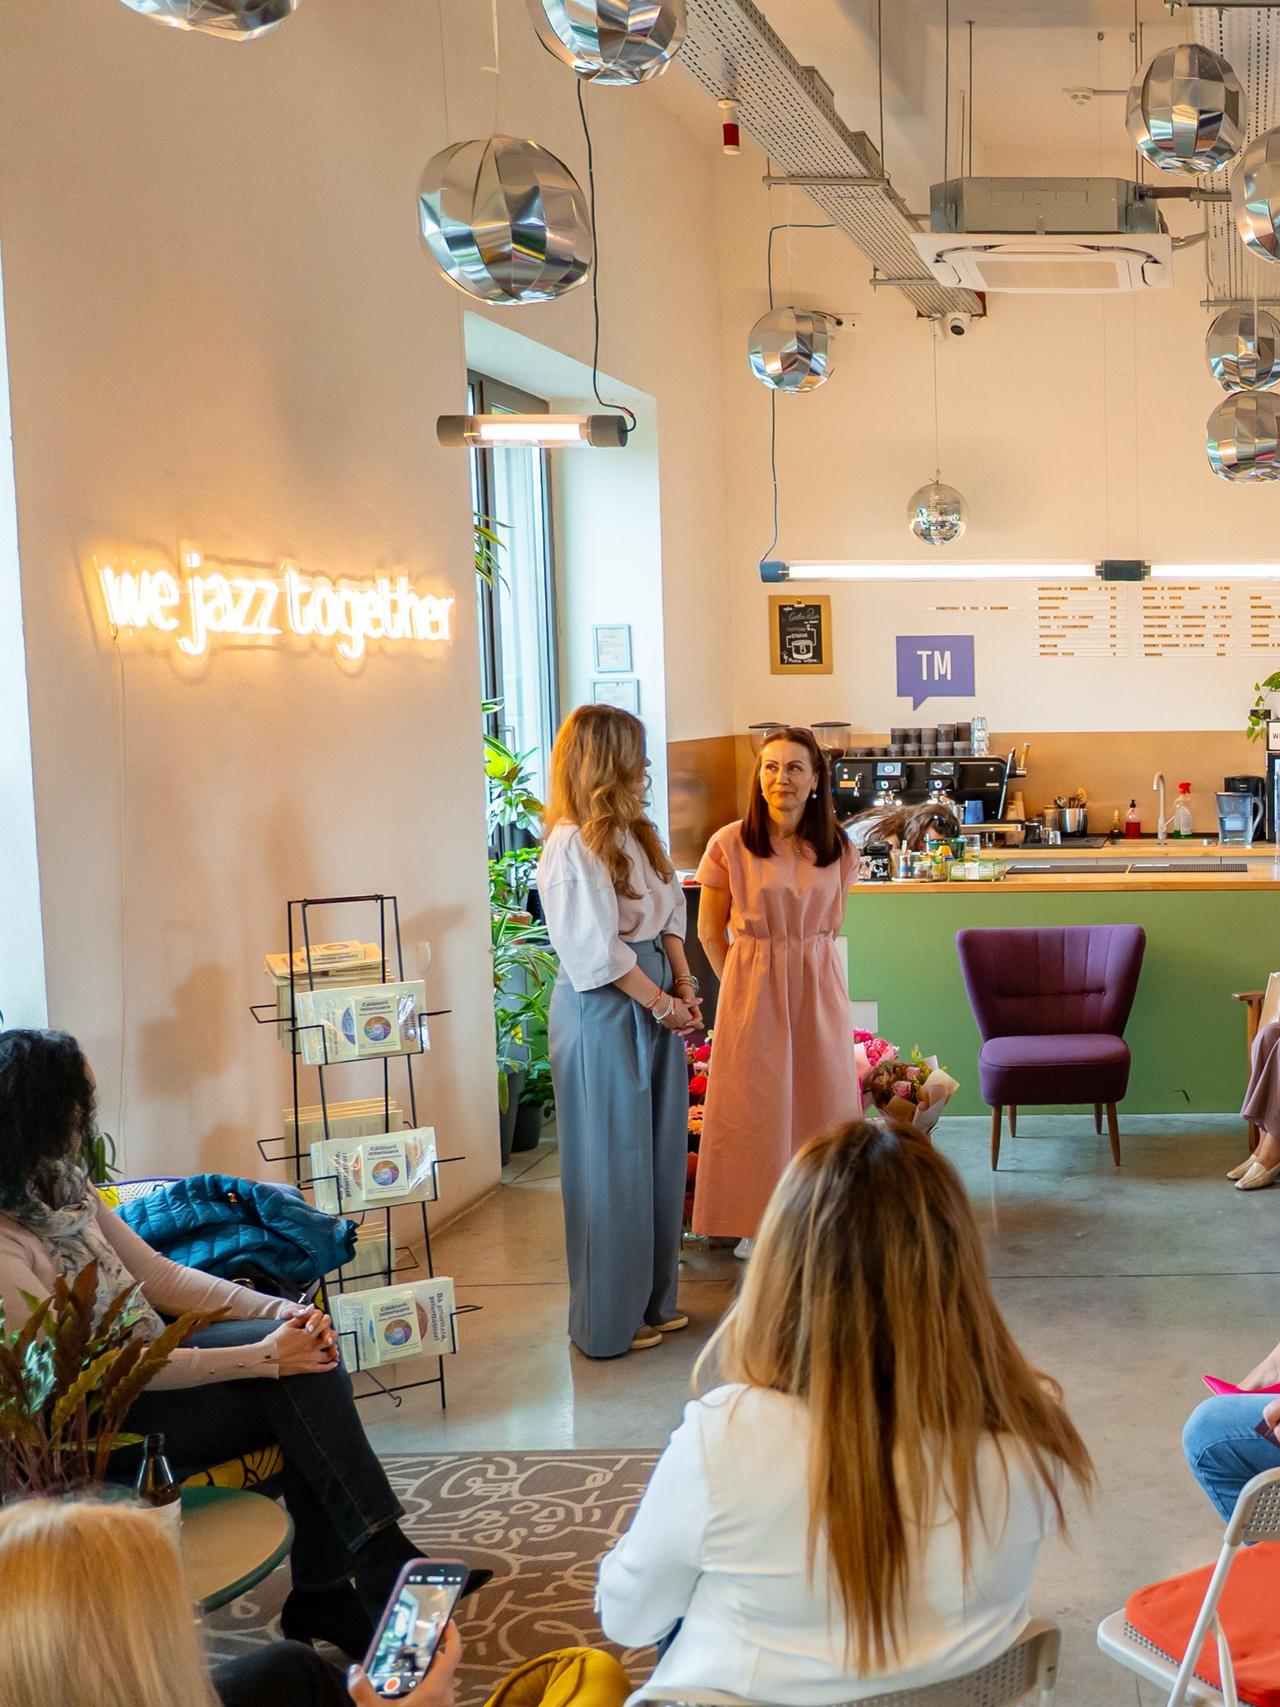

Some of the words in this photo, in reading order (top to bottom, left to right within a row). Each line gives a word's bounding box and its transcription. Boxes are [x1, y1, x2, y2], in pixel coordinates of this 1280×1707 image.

[99, 566, 180, 630] we
[176, 551, 283, 655] jazz
[284, 567, 455, 659] together
[916, 650, 952, 681] TM
